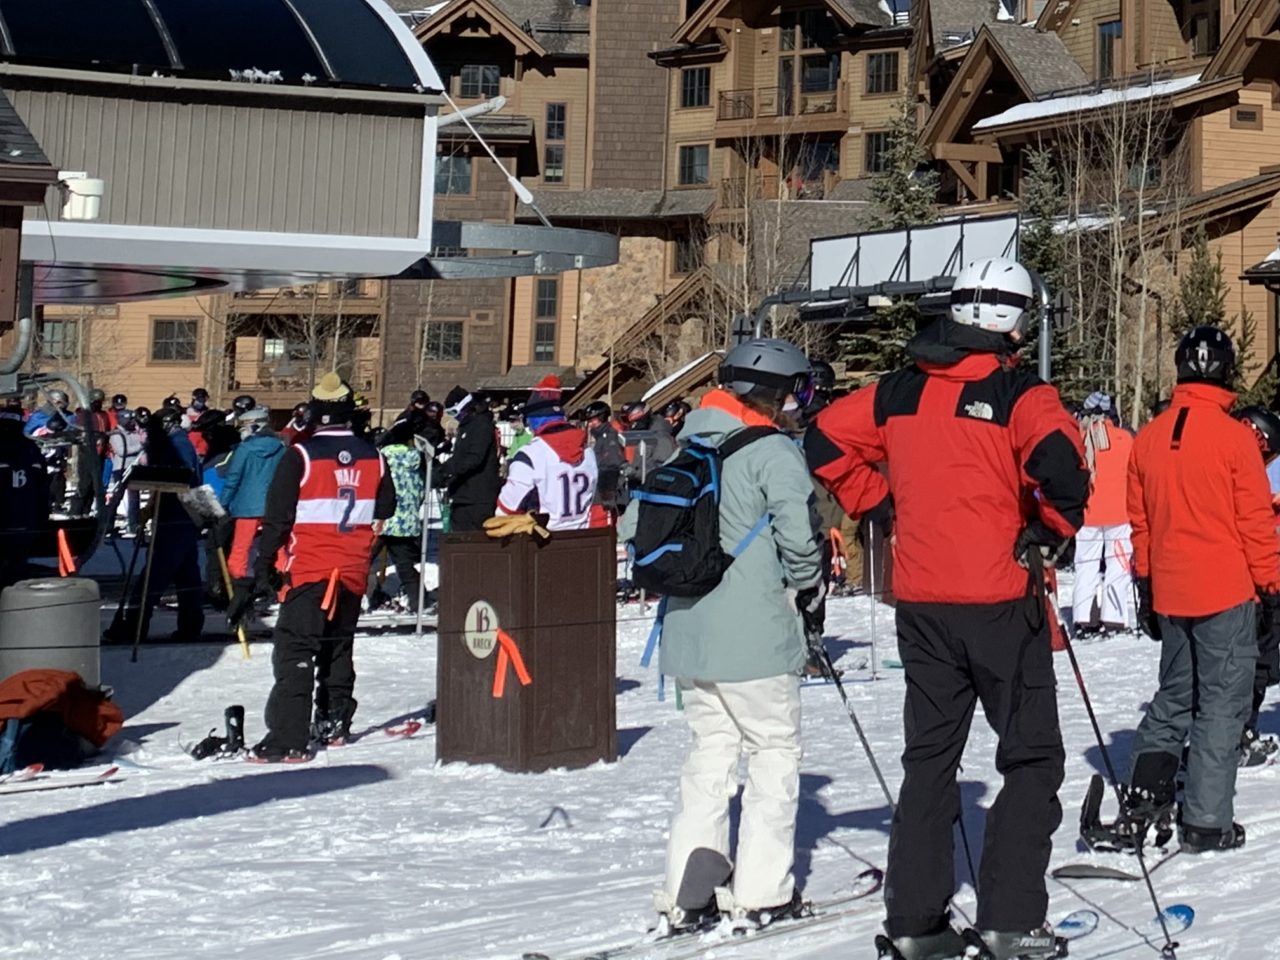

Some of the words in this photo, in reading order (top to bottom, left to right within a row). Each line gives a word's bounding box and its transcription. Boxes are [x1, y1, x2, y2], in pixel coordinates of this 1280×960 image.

[334, 468, 361, 487] WALL
[557, 472, 590, 518] 12
[337, 486, 357, 533] 2
